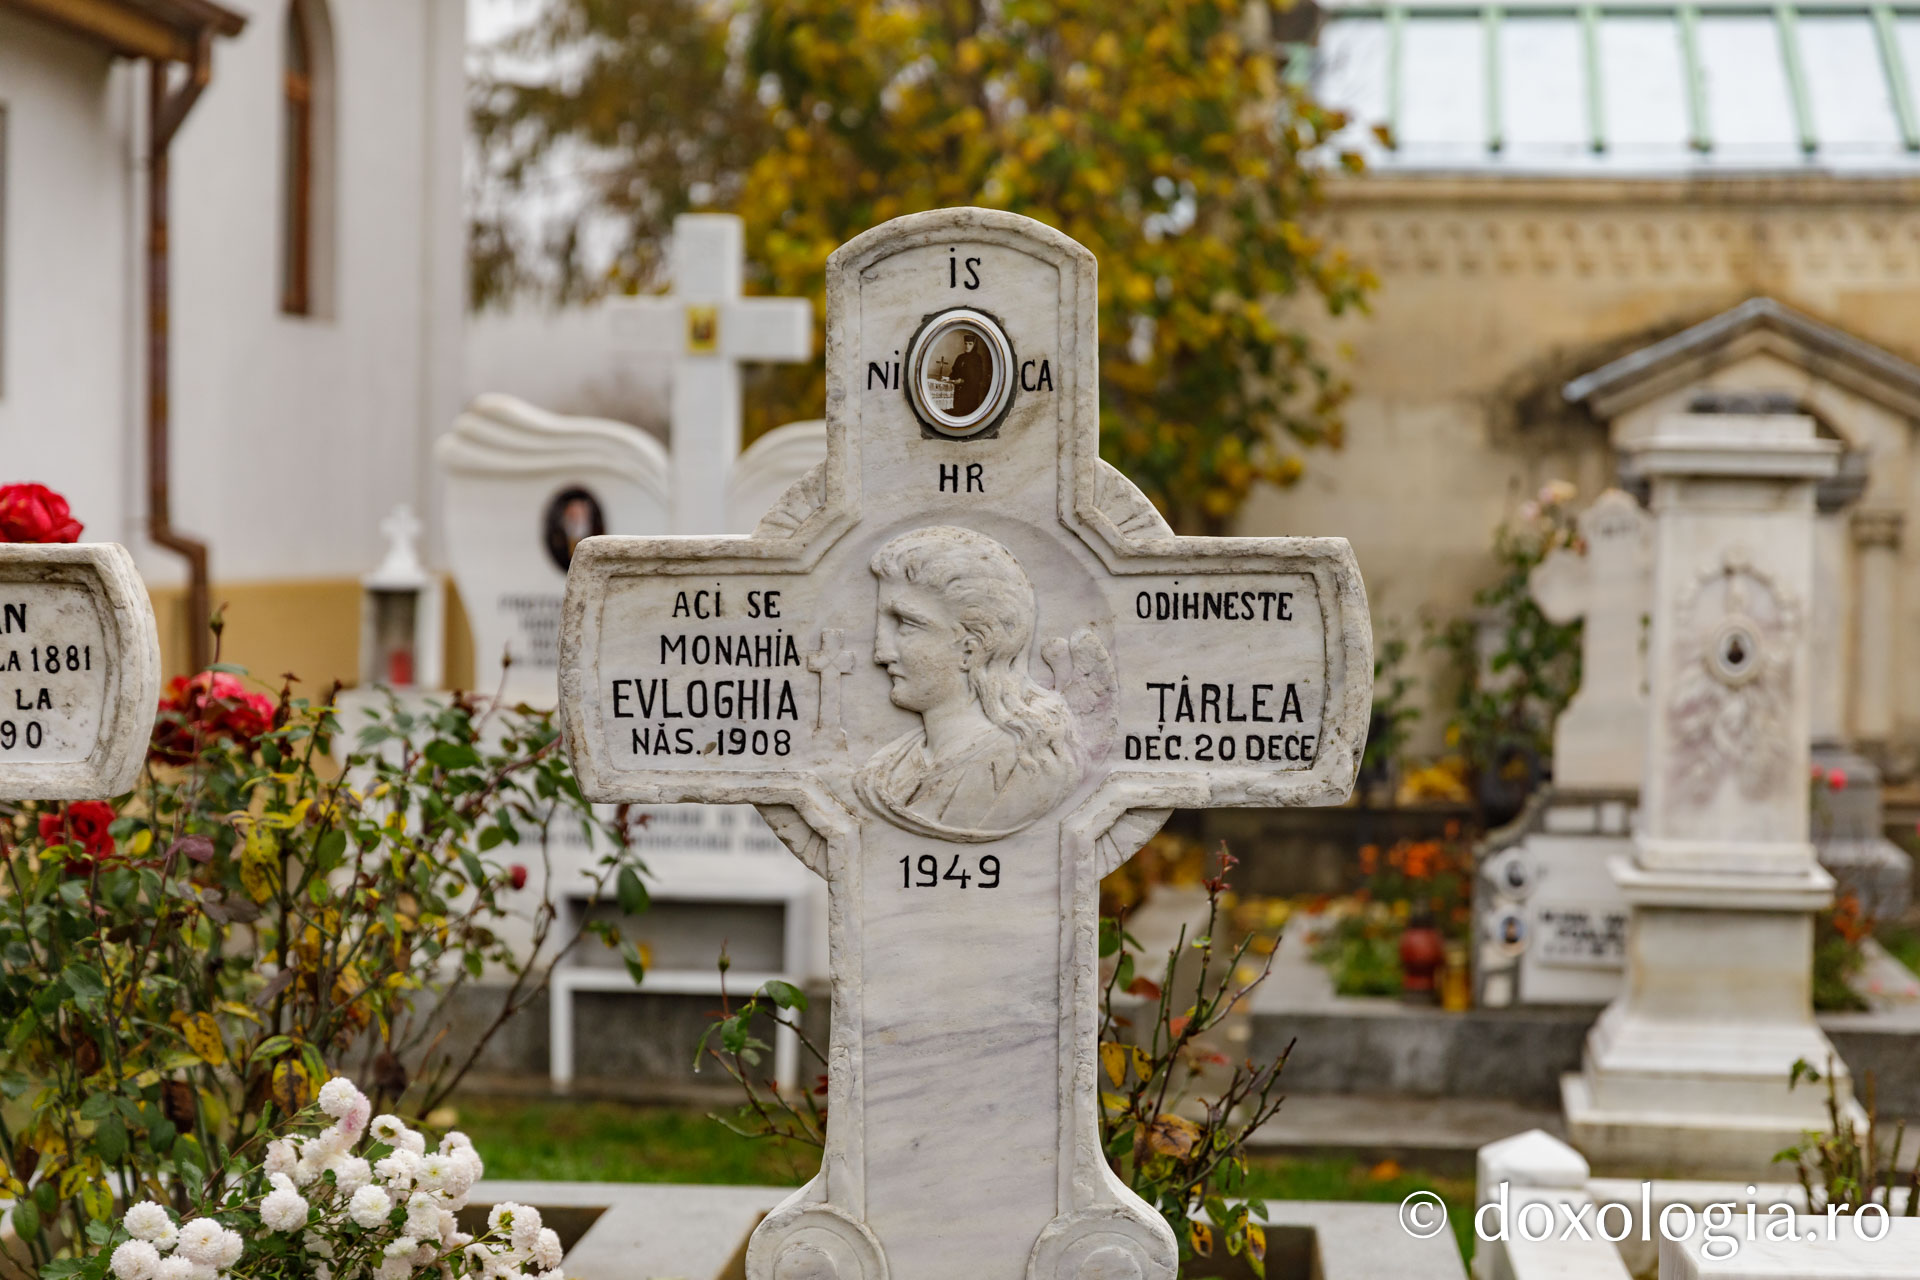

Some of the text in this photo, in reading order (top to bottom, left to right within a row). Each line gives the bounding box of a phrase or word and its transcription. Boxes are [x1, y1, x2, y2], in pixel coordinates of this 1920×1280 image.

[1020, 359, 1054, 392] CA
[939, 463, 985, 493] HR
[0, 603, 27, 634] N
[747, 590, 781, 619] SE
[0, 645, 91, 674] A 1881
[15, 688, 52, 710] LA
[612, 678, 798, 721] EVLOGHIA
[716, 727, 792, 756] 1908
[1194, 734, 1236, 761] 20
[1245, 735, 1316, 761] DECE
[899, 854, 1000, 889] 1949
